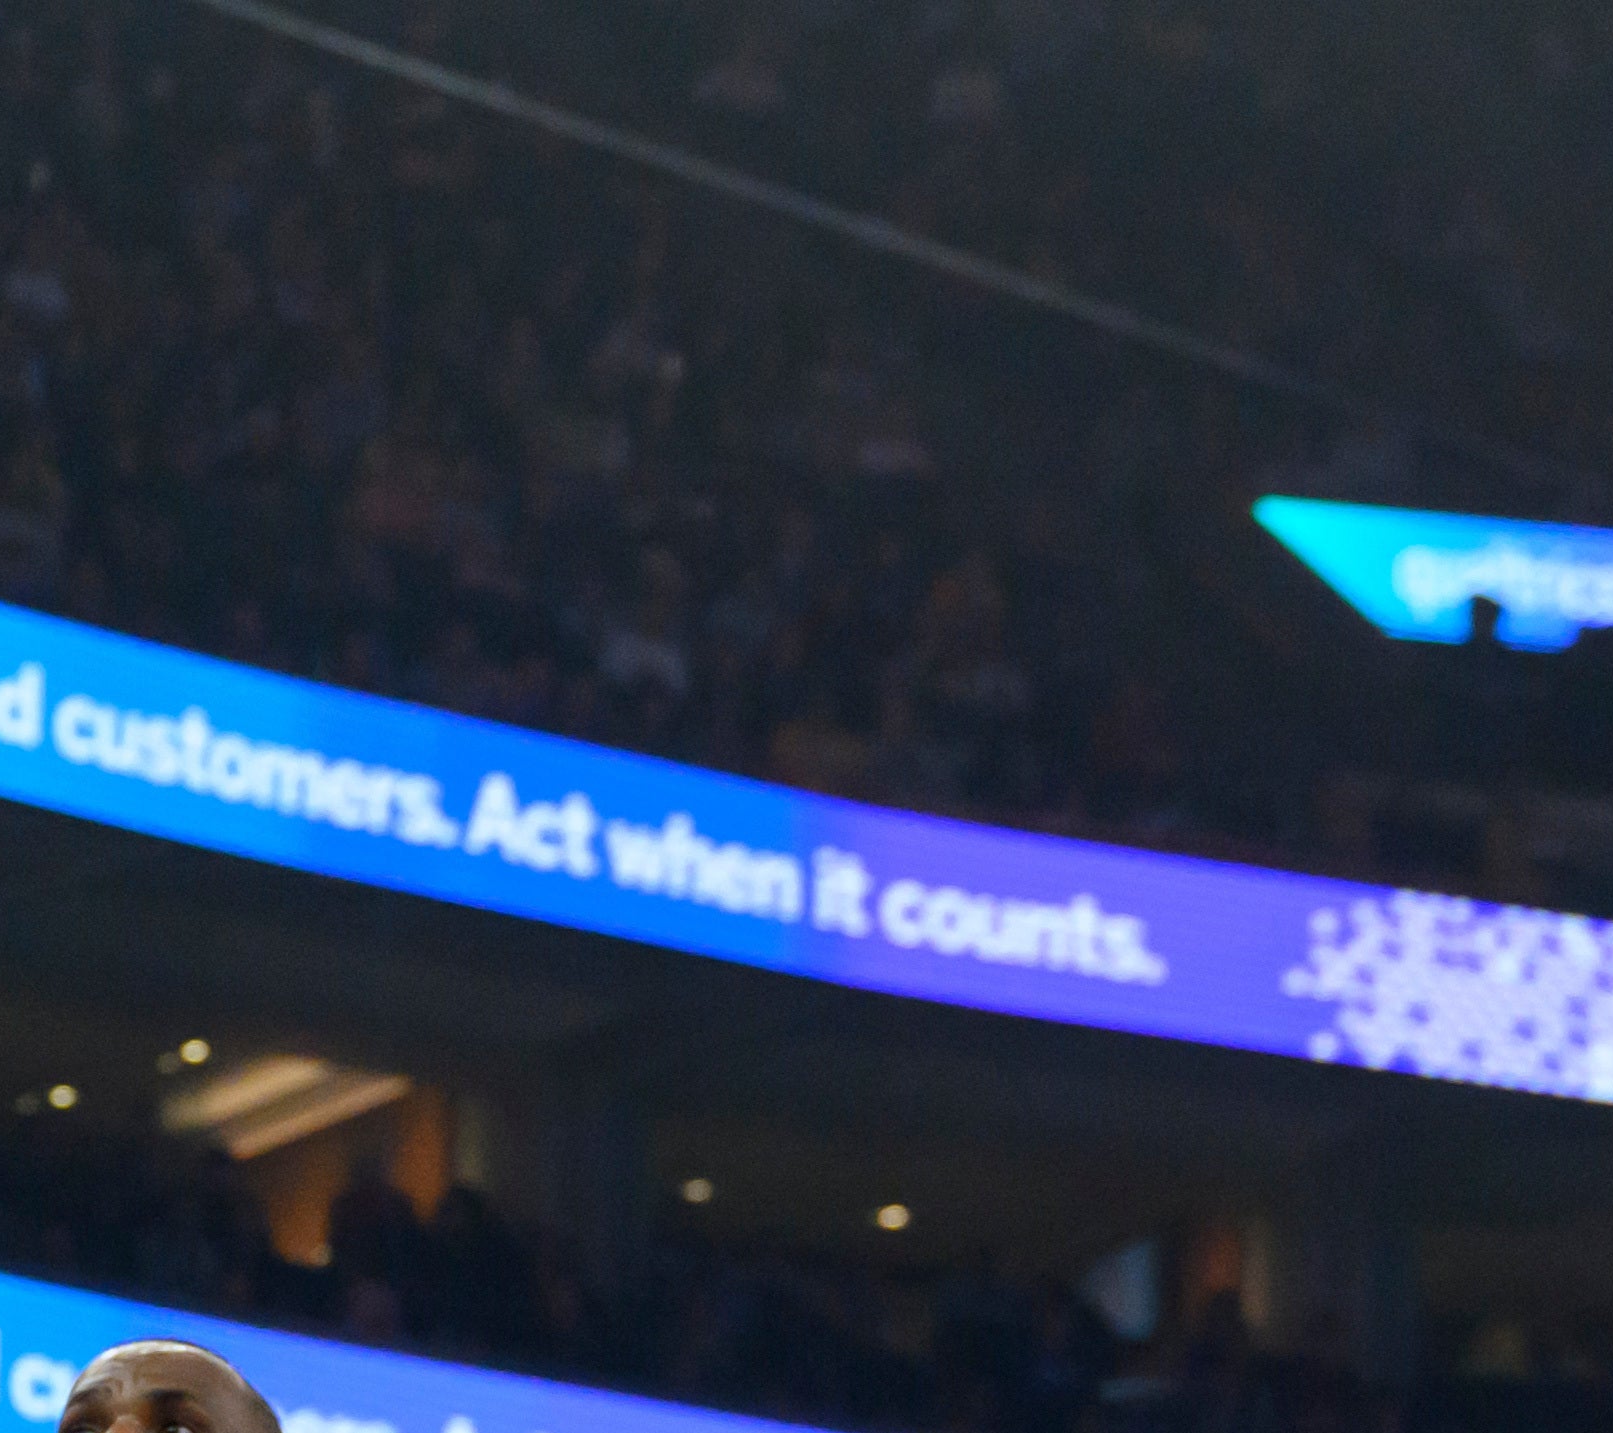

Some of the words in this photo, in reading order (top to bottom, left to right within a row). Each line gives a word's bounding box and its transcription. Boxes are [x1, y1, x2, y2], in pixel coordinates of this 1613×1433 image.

[52, 692, 460, 848] customers.
[466, 772, 599, 880] Act
[606, 812, 802, 923] when
[812, 845, 872, 938] it
[880, 878, 1168, 987] counts.
